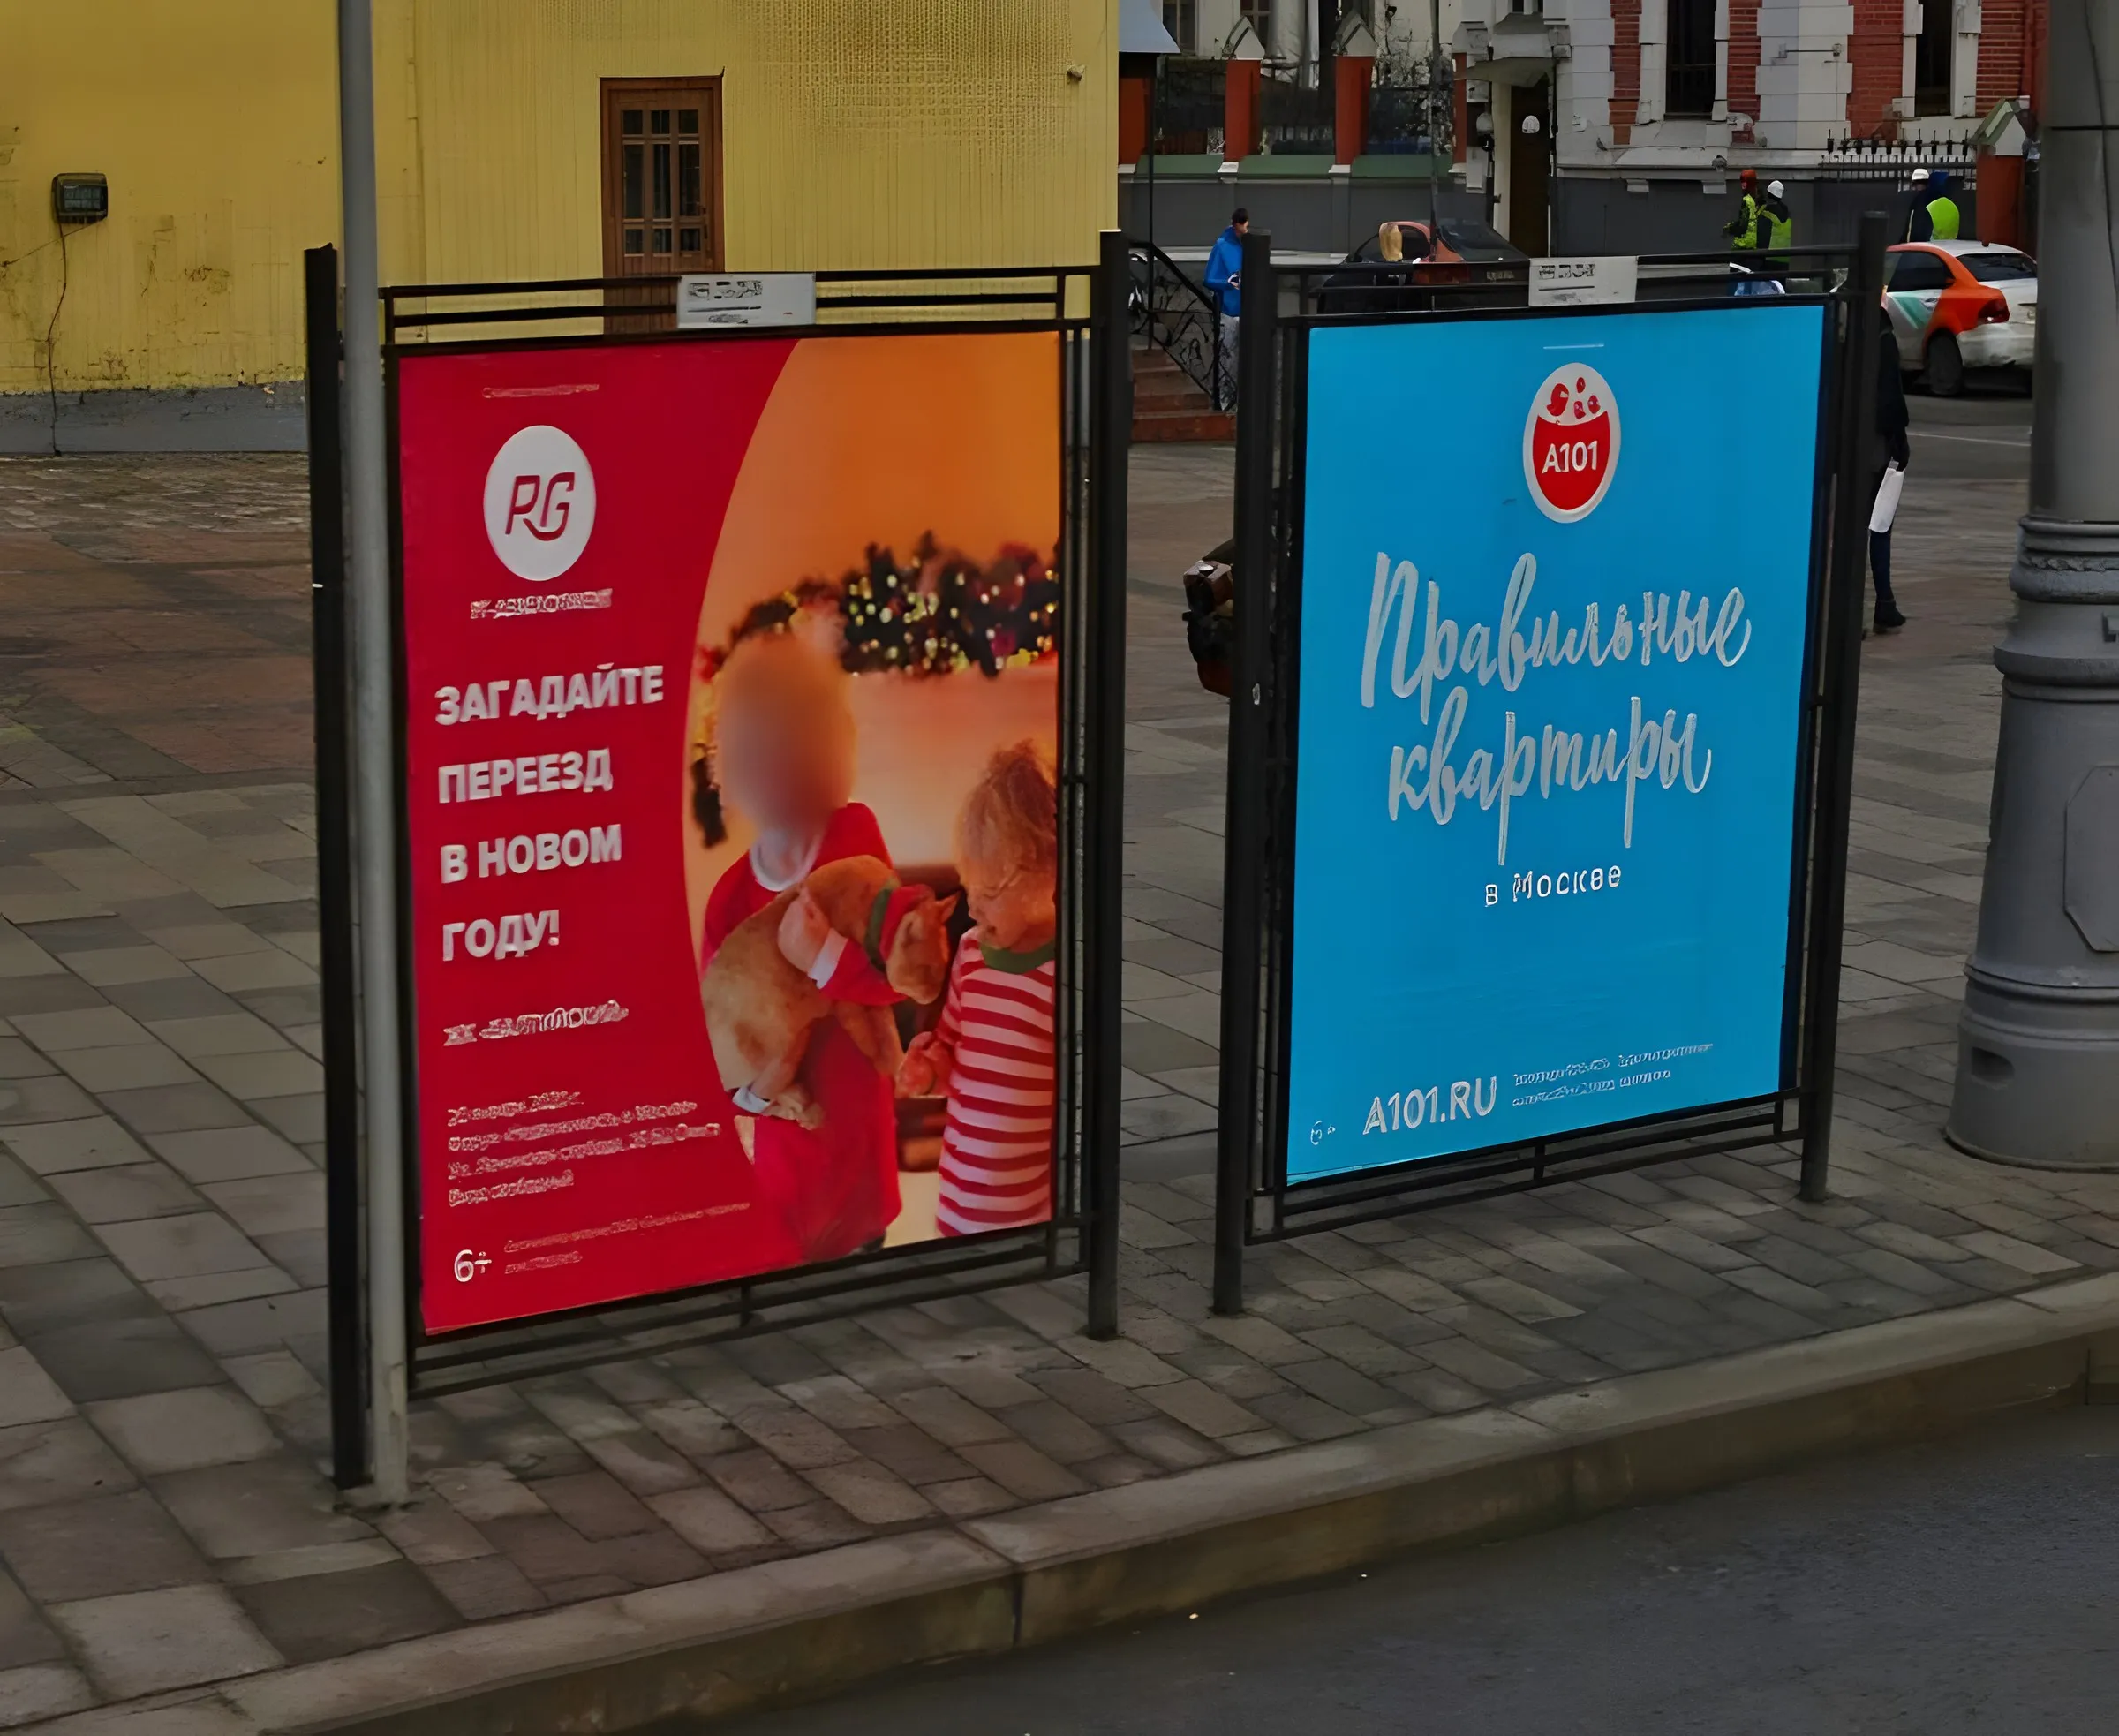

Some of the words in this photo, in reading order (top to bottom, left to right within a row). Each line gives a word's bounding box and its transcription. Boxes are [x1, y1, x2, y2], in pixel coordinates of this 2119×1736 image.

[1542, 441, 1598, 473] A101
[505, 472, 575, 540] RG
[1361, 551, 1752, 726] Правильные
[435, 663, 664, 726] ЗАГАДАЙТЕ
[438, 747, 613, 804] ПЕРЕЕЗД
[1388, 686, 1711, 866] квартиры
[441, 844, 469, 884] В
[478, 824, 622, 878] НОВОМ
[1512, 865, 1622, 902] Москве
[442, 910, 560, 962] ГОДУ!
[1362, 1076, 1497, 1136] A101.RU
